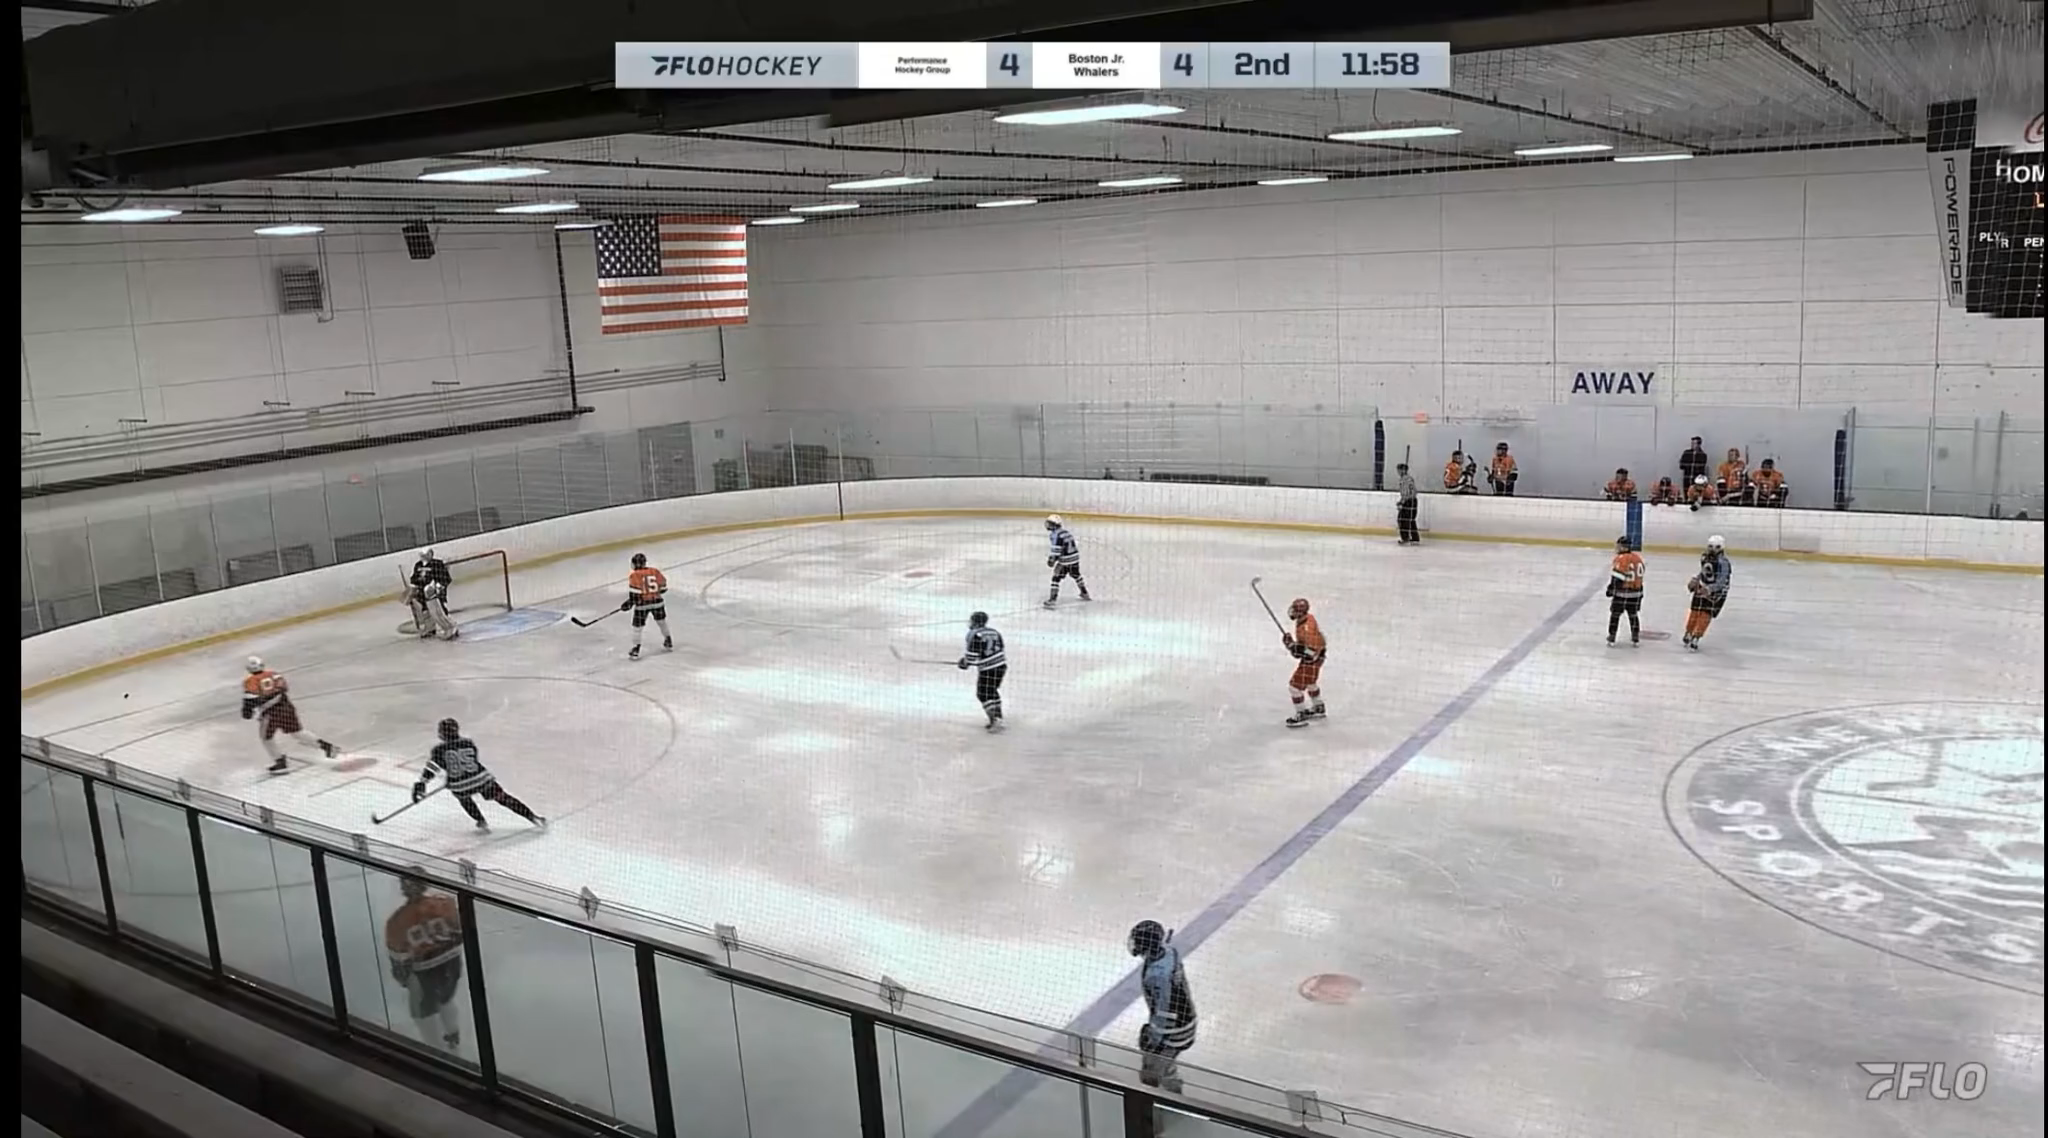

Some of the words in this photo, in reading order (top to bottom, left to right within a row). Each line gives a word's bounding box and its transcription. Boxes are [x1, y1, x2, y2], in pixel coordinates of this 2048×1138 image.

[1943, 157, 1963, 296] POWERADE
[1571, 371, 1655, 394] AWAY
[642, 574, 660, 593] 15
[1708, 798, 2034, 964] SPORTS
